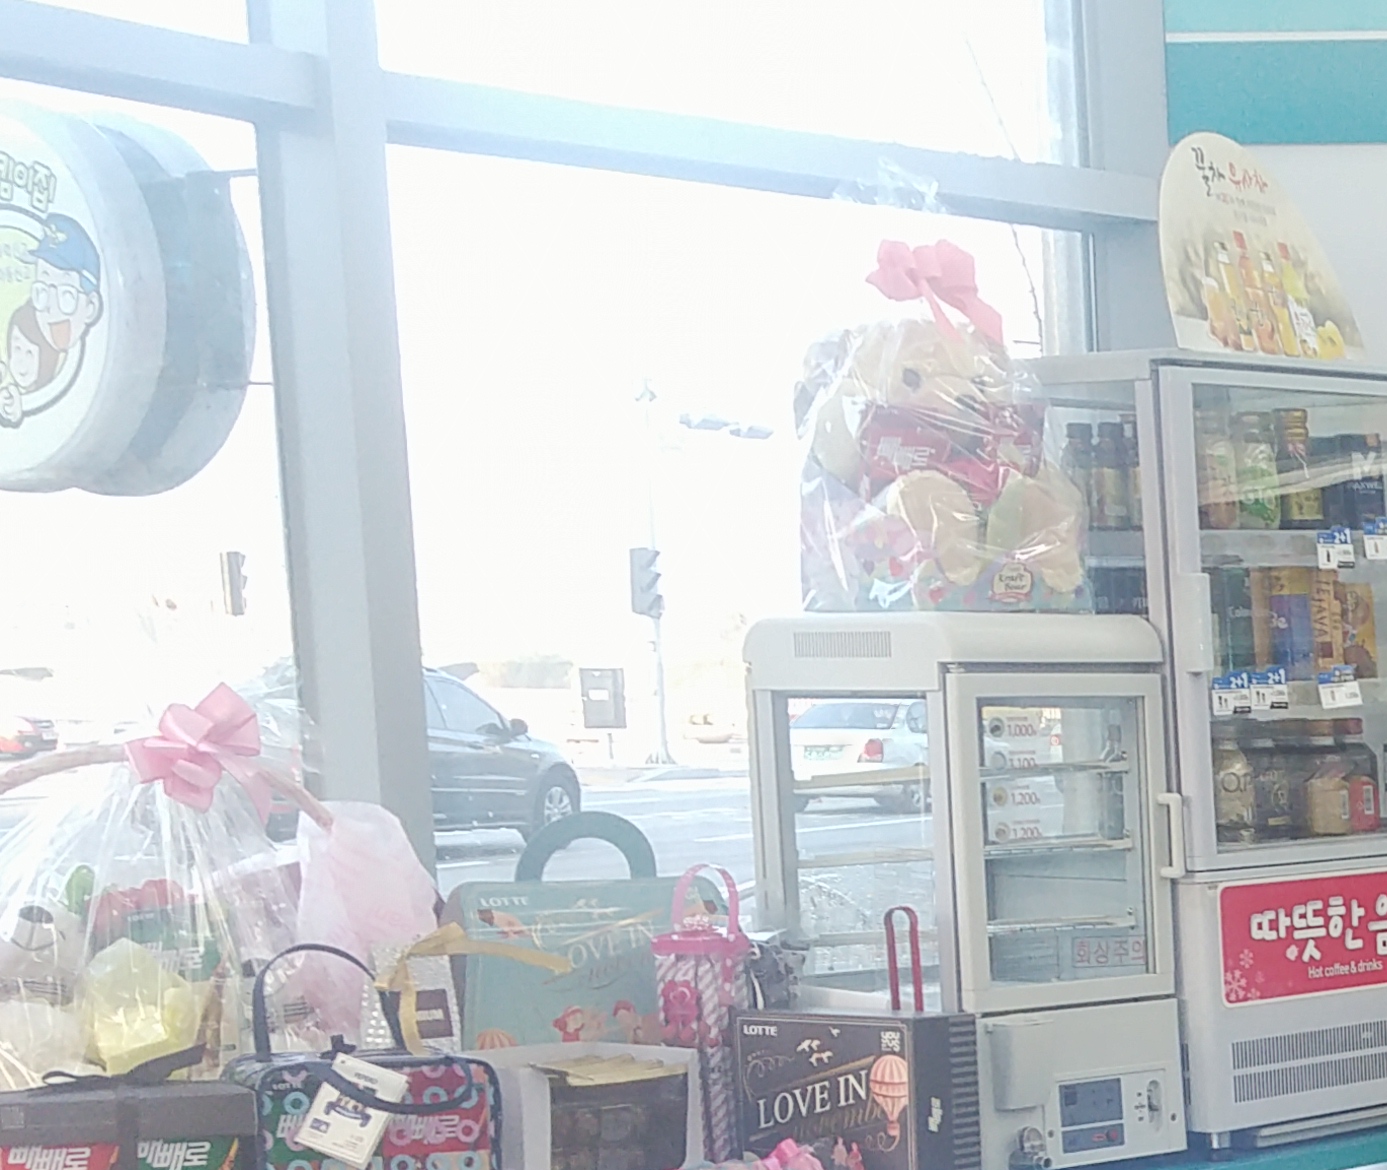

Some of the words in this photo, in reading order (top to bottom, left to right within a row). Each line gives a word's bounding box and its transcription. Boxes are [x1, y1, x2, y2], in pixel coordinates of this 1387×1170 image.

[1230, 673, 1250, 688] 2+1
[1266, 669, 1287, 684] 2+1
[1251, 895, 1366, 962] 따뜻한
[1308, 966, 1323, 979] Hot
[1324, 963, 1350, 977] coffee
[1357, 959, 1383, 973] drinks
[743, 1025, 777, 1037] LOTTE
[757, 1080, 831, 1129] LOVE
[837, 1069, 869, 1108] IN
